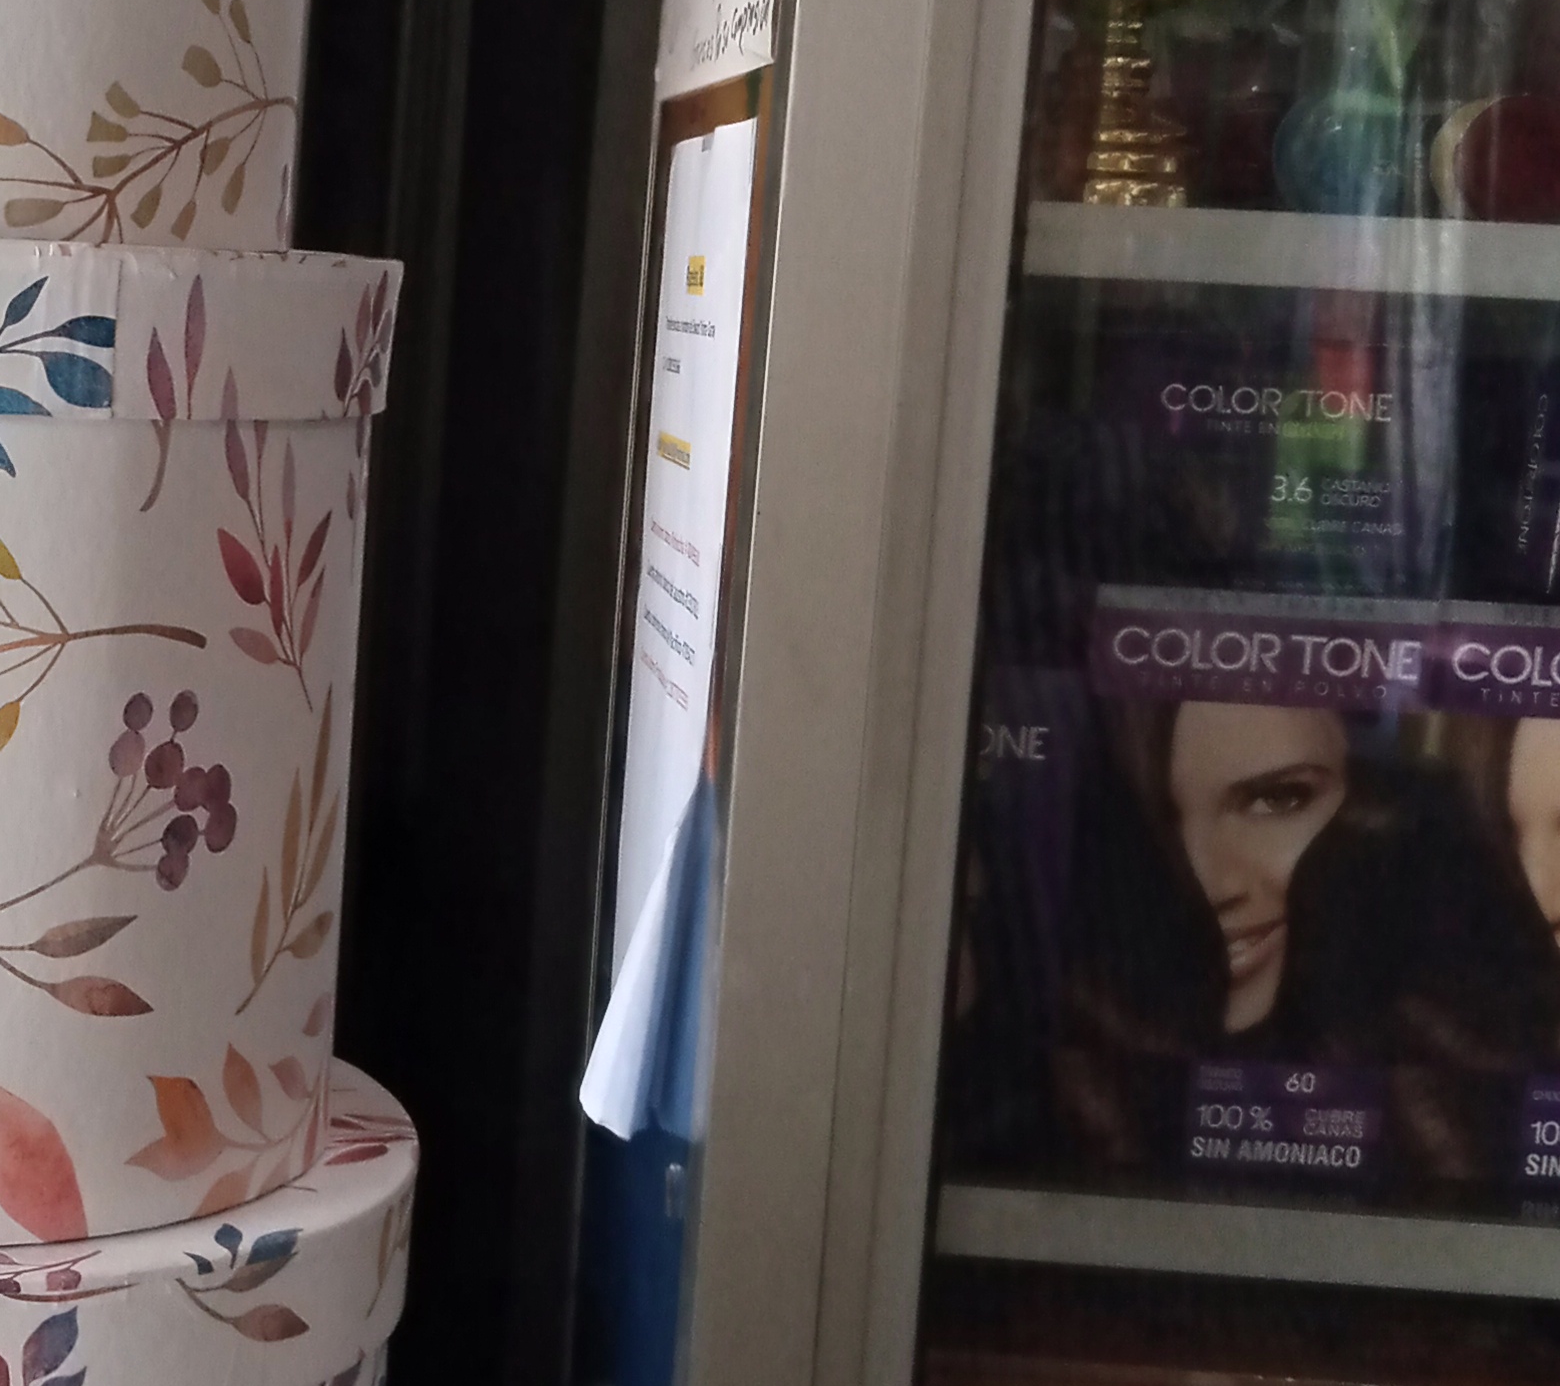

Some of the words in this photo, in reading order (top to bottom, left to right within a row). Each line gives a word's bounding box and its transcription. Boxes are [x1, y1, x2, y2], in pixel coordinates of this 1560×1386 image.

[1160, 383, 1283, 416] COLOR
[1297, 389, 1393, 423] TONE
[1270, 475, 1314, 503] 3.6
[1113, 625, 1283, 676] COLOR
[1291, 635, 1422, 683] TONE
[1452, 642, 1560, 688] COL
[1481, 687, 1560, 708] TINTE
[1285, 1072, 1316, 1094] 60
[1197, 1104, 1244, 1130] 100
[1249, 1106, 1274, 1131] %
[1530, 1120, 1560, 1146] 10
[1190, 1137, 1231, 1159] SIN
[1237, 1140, 1362, 1169] AMONIACO
